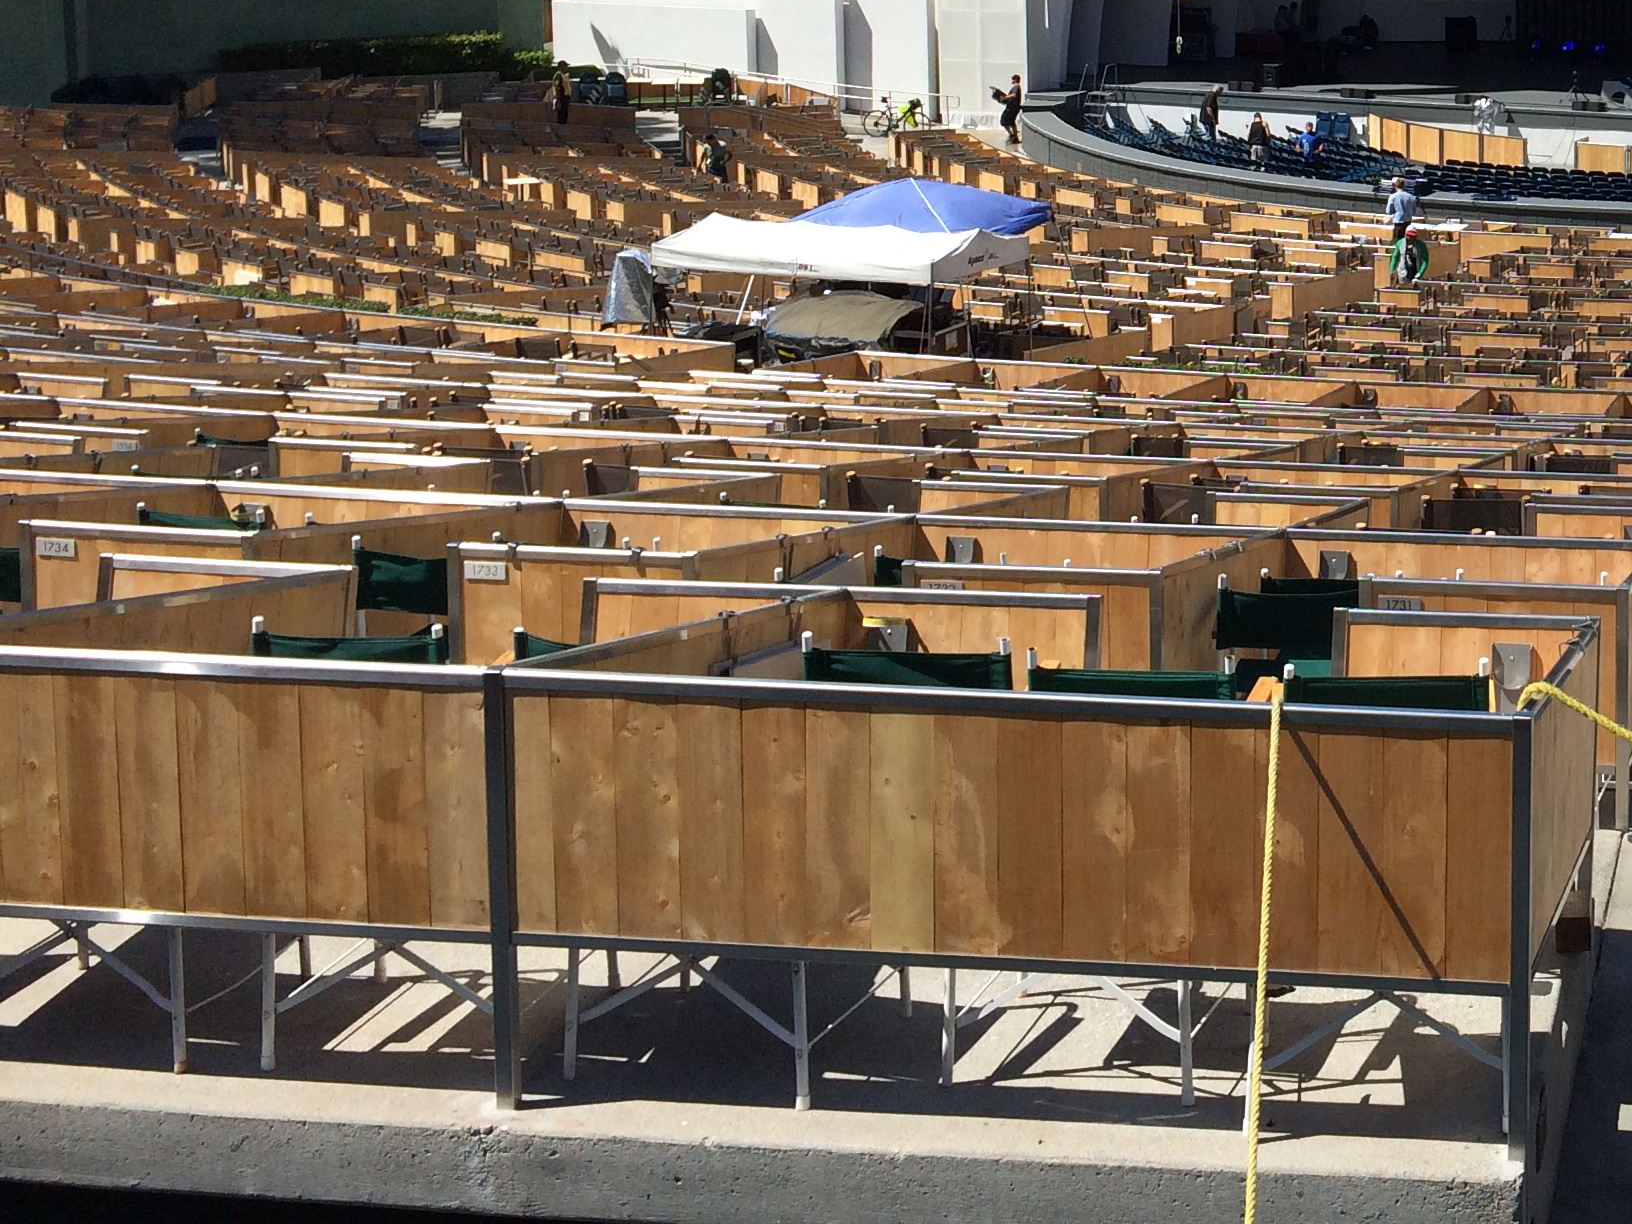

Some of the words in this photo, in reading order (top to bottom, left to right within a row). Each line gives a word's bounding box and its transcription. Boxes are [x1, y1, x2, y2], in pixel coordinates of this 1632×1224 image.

[43, 540, 69, 553] 1734
[472, 564, 499, 577] 1733
[1386, 599, 1412, 611] 1731
